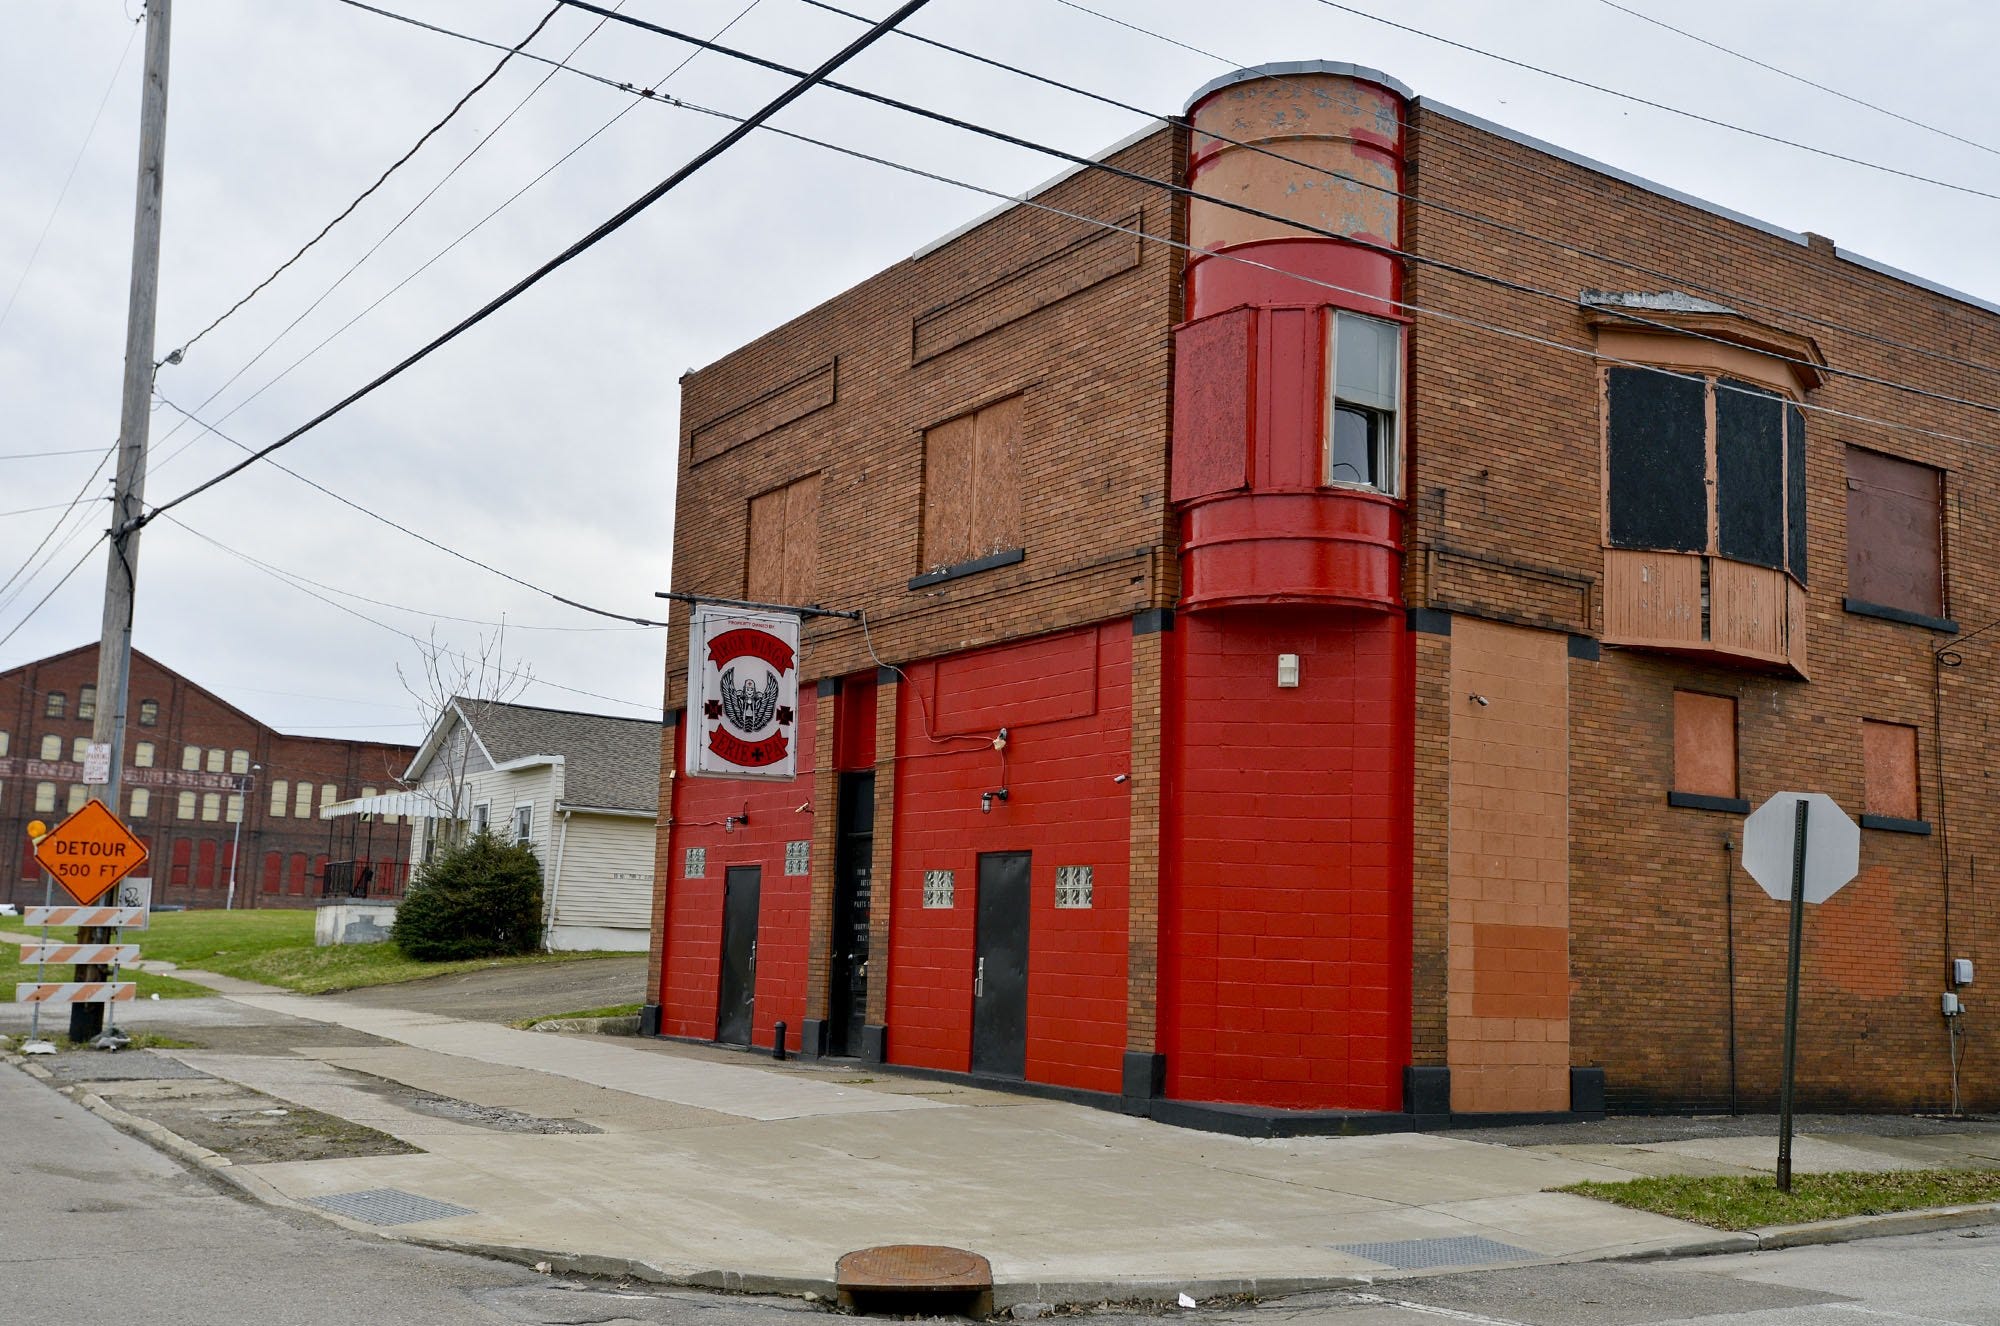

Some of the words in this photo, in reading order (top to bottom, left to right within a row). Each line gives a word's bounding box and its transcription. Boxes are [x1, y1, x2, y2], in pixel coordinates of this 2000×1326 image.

[714, 634, 746, 660] IRON
[751, 636, 789, 665] WINGS
[717, 734, 748, 762] ERIE
[766, 740, 784, 761] PA
[56, 841, 126, 857] DETOUR
[59, 864, 90, 877] 500
[100, 865, 118, 877] FT
